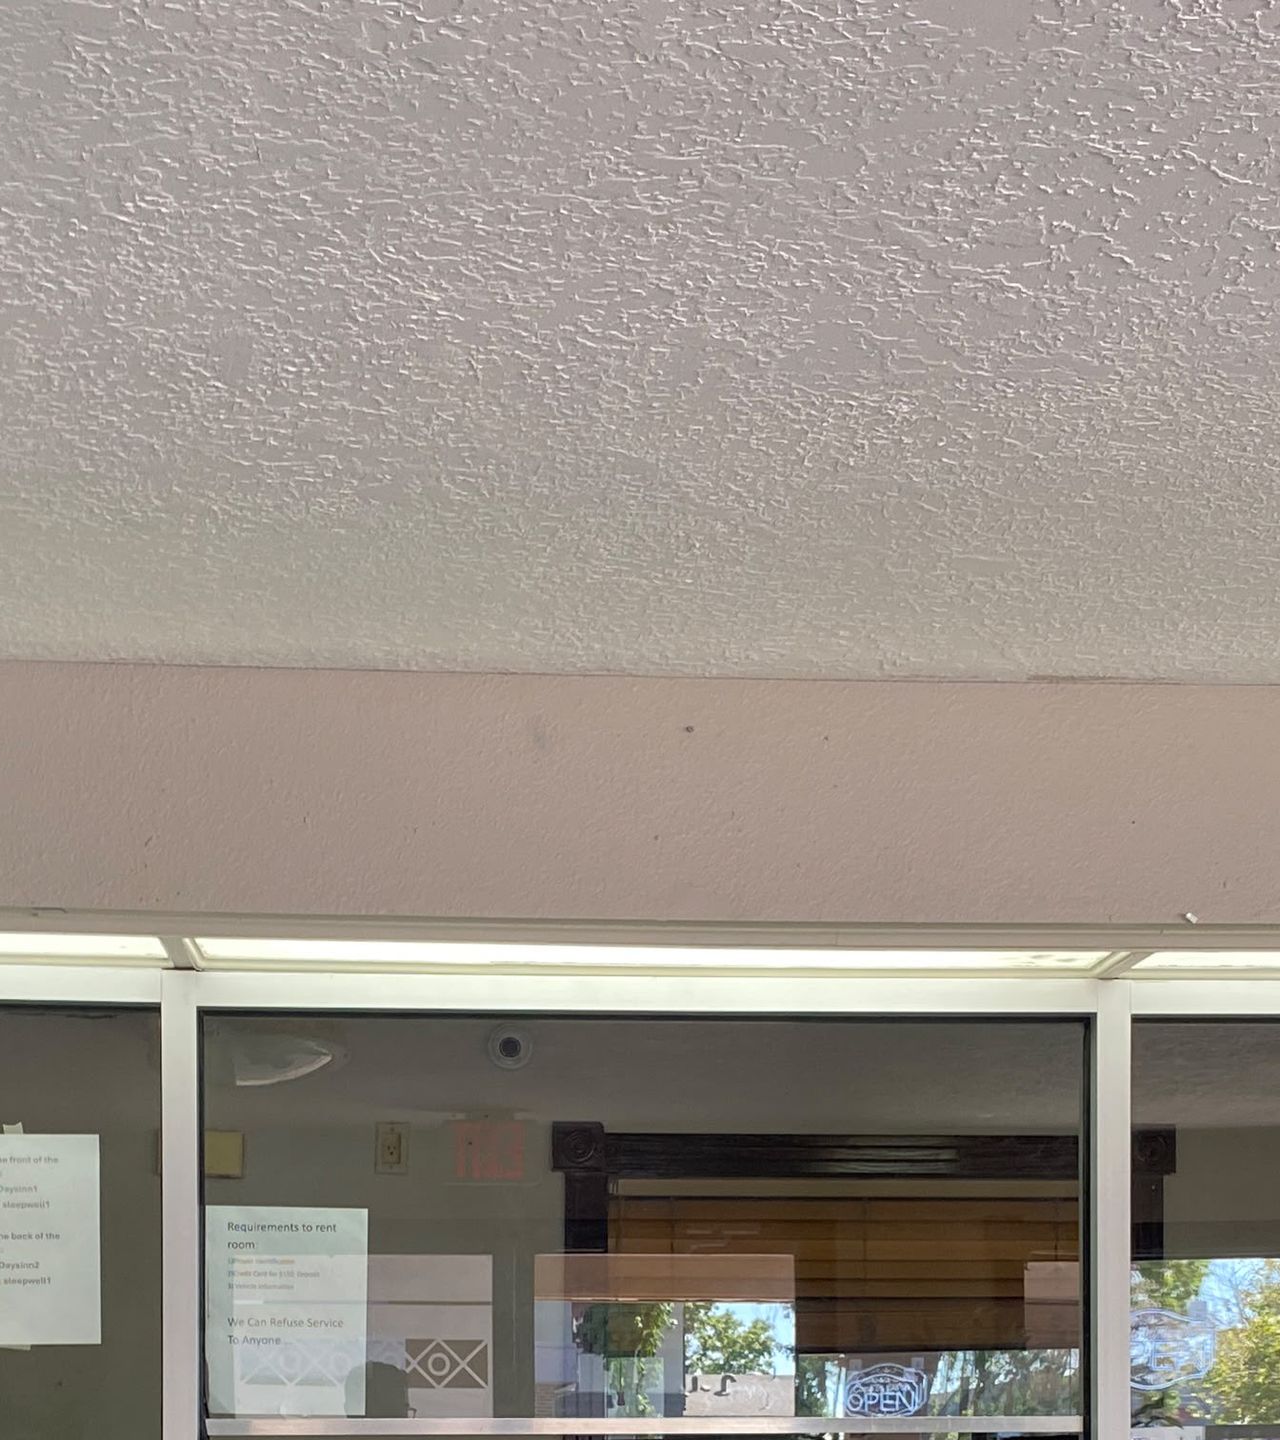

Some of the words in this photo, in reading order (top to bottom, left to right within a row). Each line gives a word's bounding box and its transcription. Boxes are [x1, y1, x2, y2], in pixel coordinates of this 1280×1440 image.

[9, 1155, 32, 1164] front
[32, 1155, 42, 1164] of
[43, 1155, 59, 1164] the
[227, 1222, 299, 1233] Requirements
[302, 1224, 313, 1232] to
[315, 1224, 336, 1232] rent
[10, 1232, 33, 1240] back
[34, 1232, 44, 1240] of
[45, 1232, 60, 1240] the
[227, 1318, 244, 1328] We
[248, 1318, 266, 1328] Can
[270, 1318, 304, 1328] Refuse
[306, 1318, 344, 1328] Service
[227, 1335, 240, 1344] To
[848, 1392, 914, 1412] OPEN
